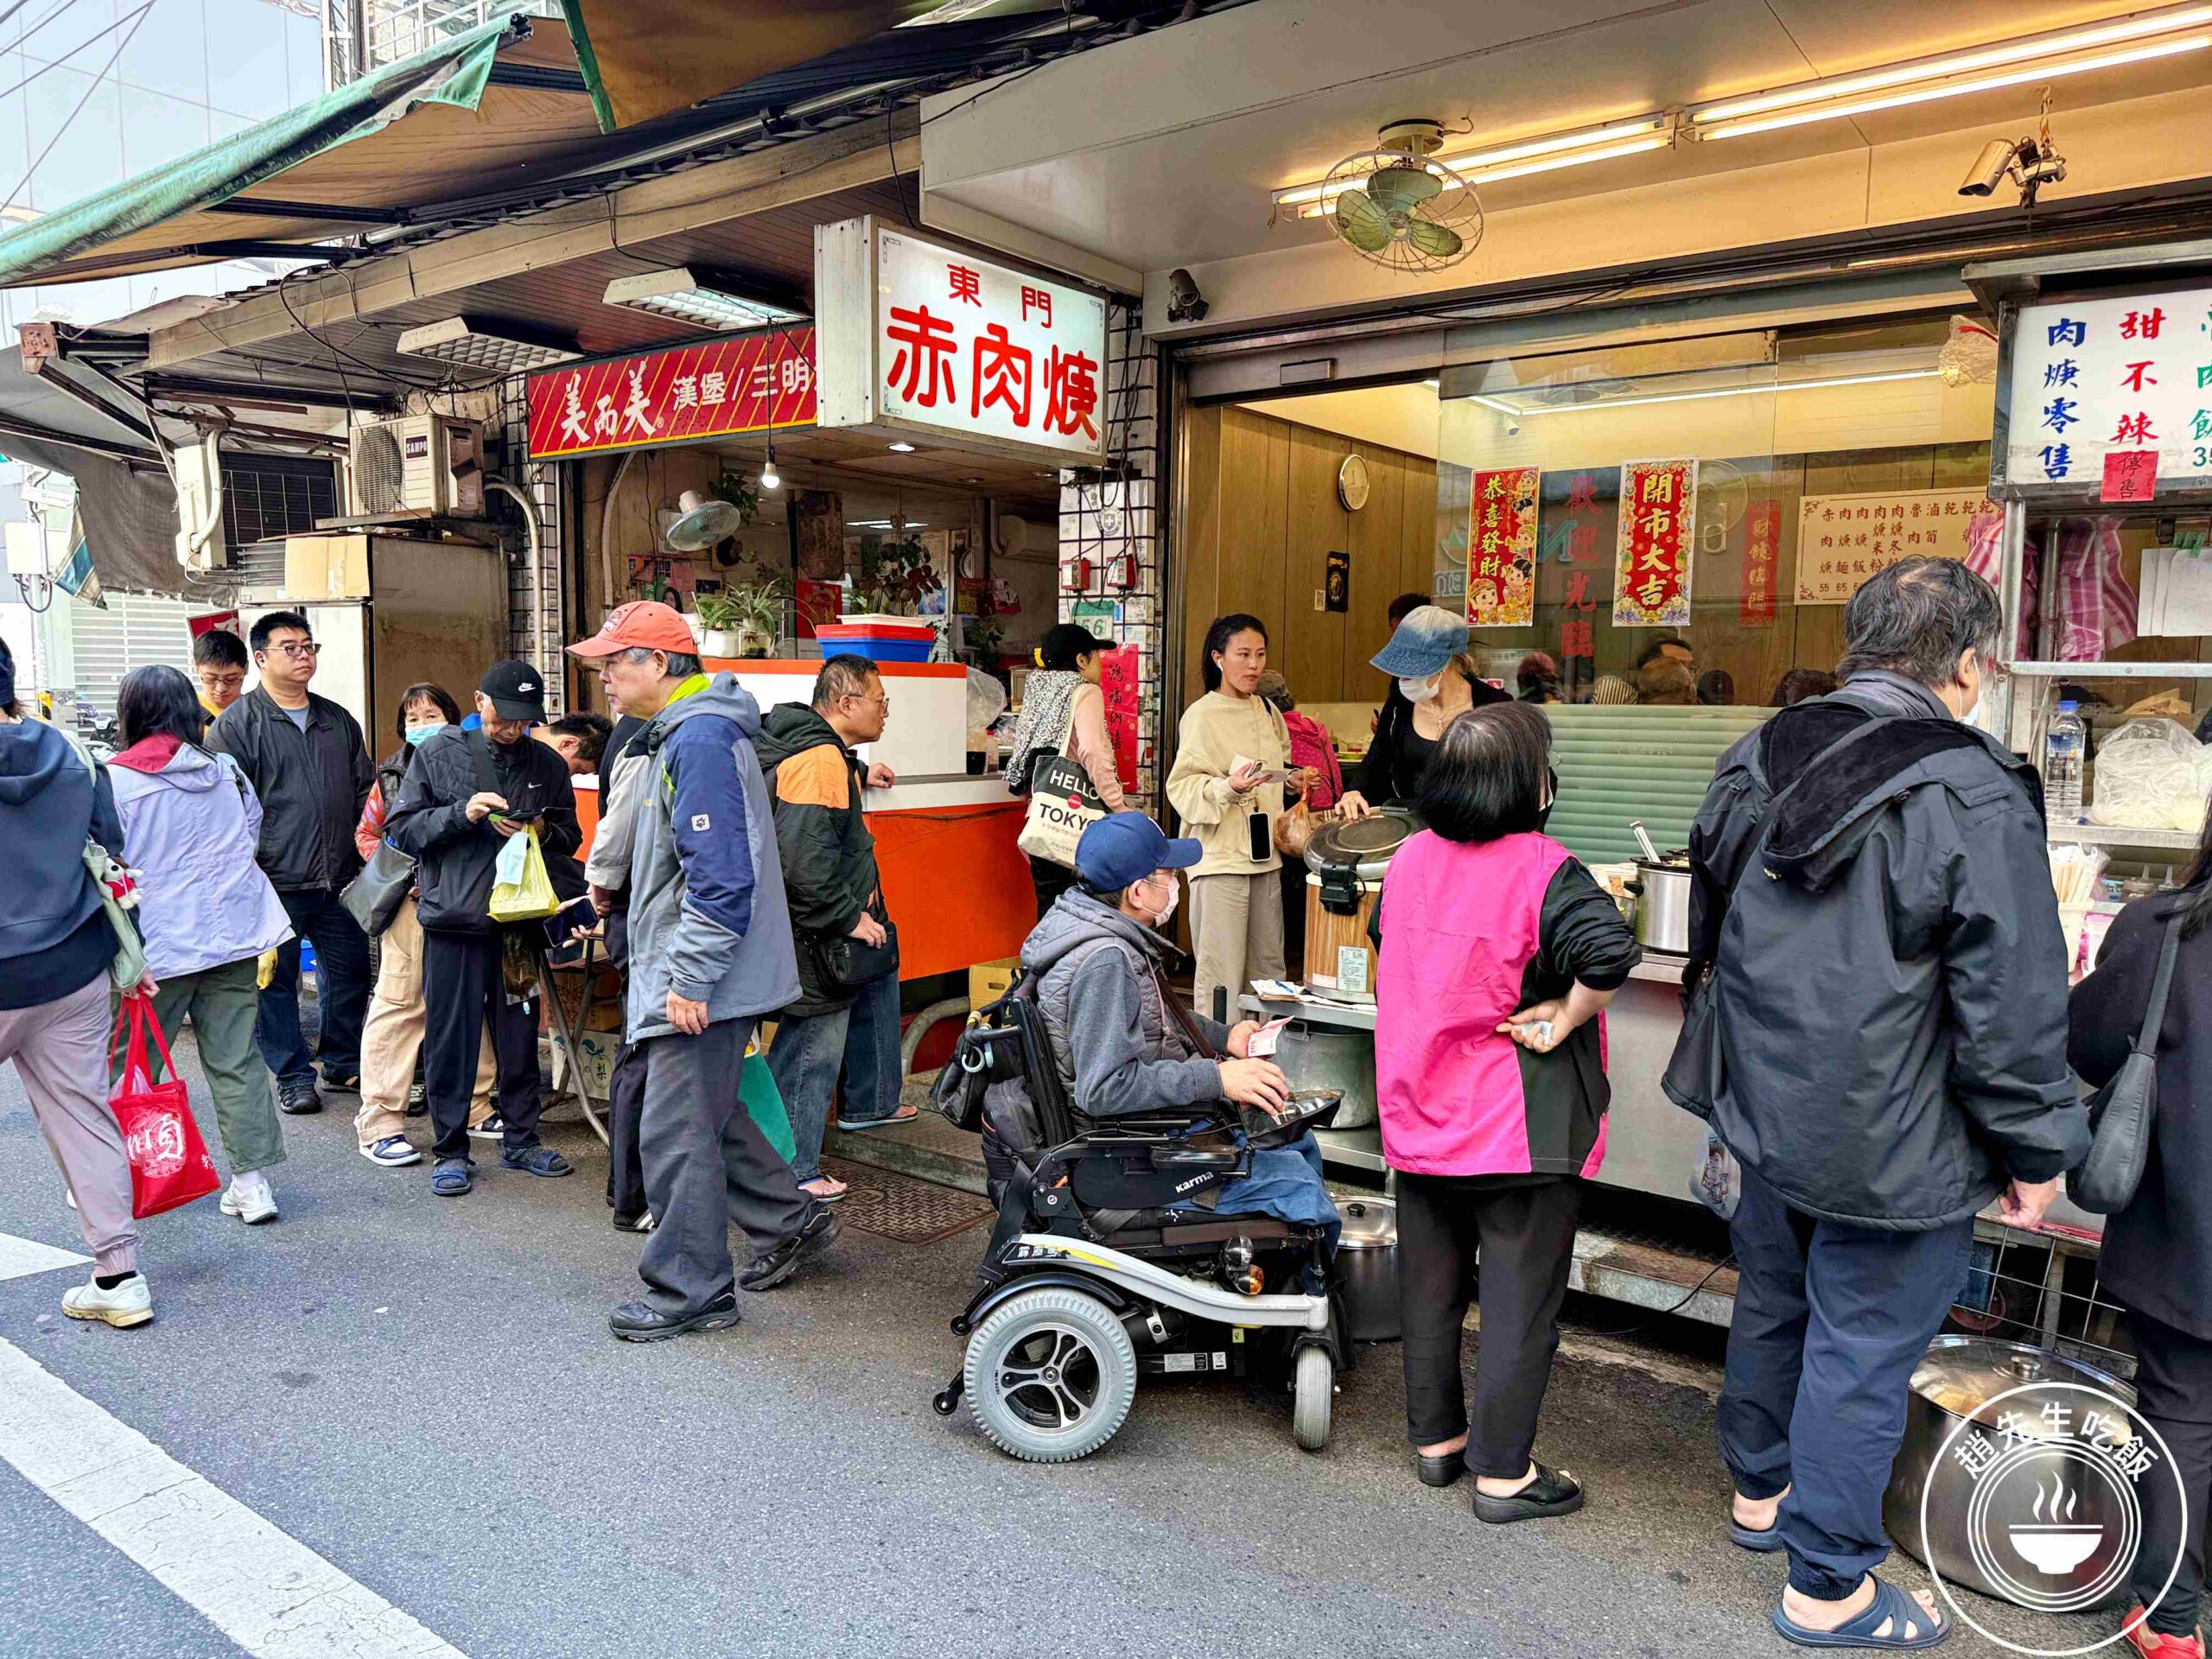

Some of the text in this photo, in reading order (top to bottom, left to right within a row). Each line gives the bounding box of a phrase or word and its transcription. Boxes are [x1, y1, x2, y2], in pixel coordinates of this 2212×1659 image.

[947, 264, 1052, 328] 東門
[561, 360, 657, 443] 美而美
[887, 305, 1098, 441] 赤肉焿
[2037, 318, 2087, 480] 肉焿零售
[2109, 307, 2167, 445] 甜不辣
[1479, 474, 1507, 577] 恭喜發財
[1636, 473, 1674, 606] 開市大吉
[1819, 583, 1829, 592] 55
[1836, 582, 1847, 592] 65
[1853, 582, 1862, 591] 6
[1050, 769, 1099, 800] HELLO
